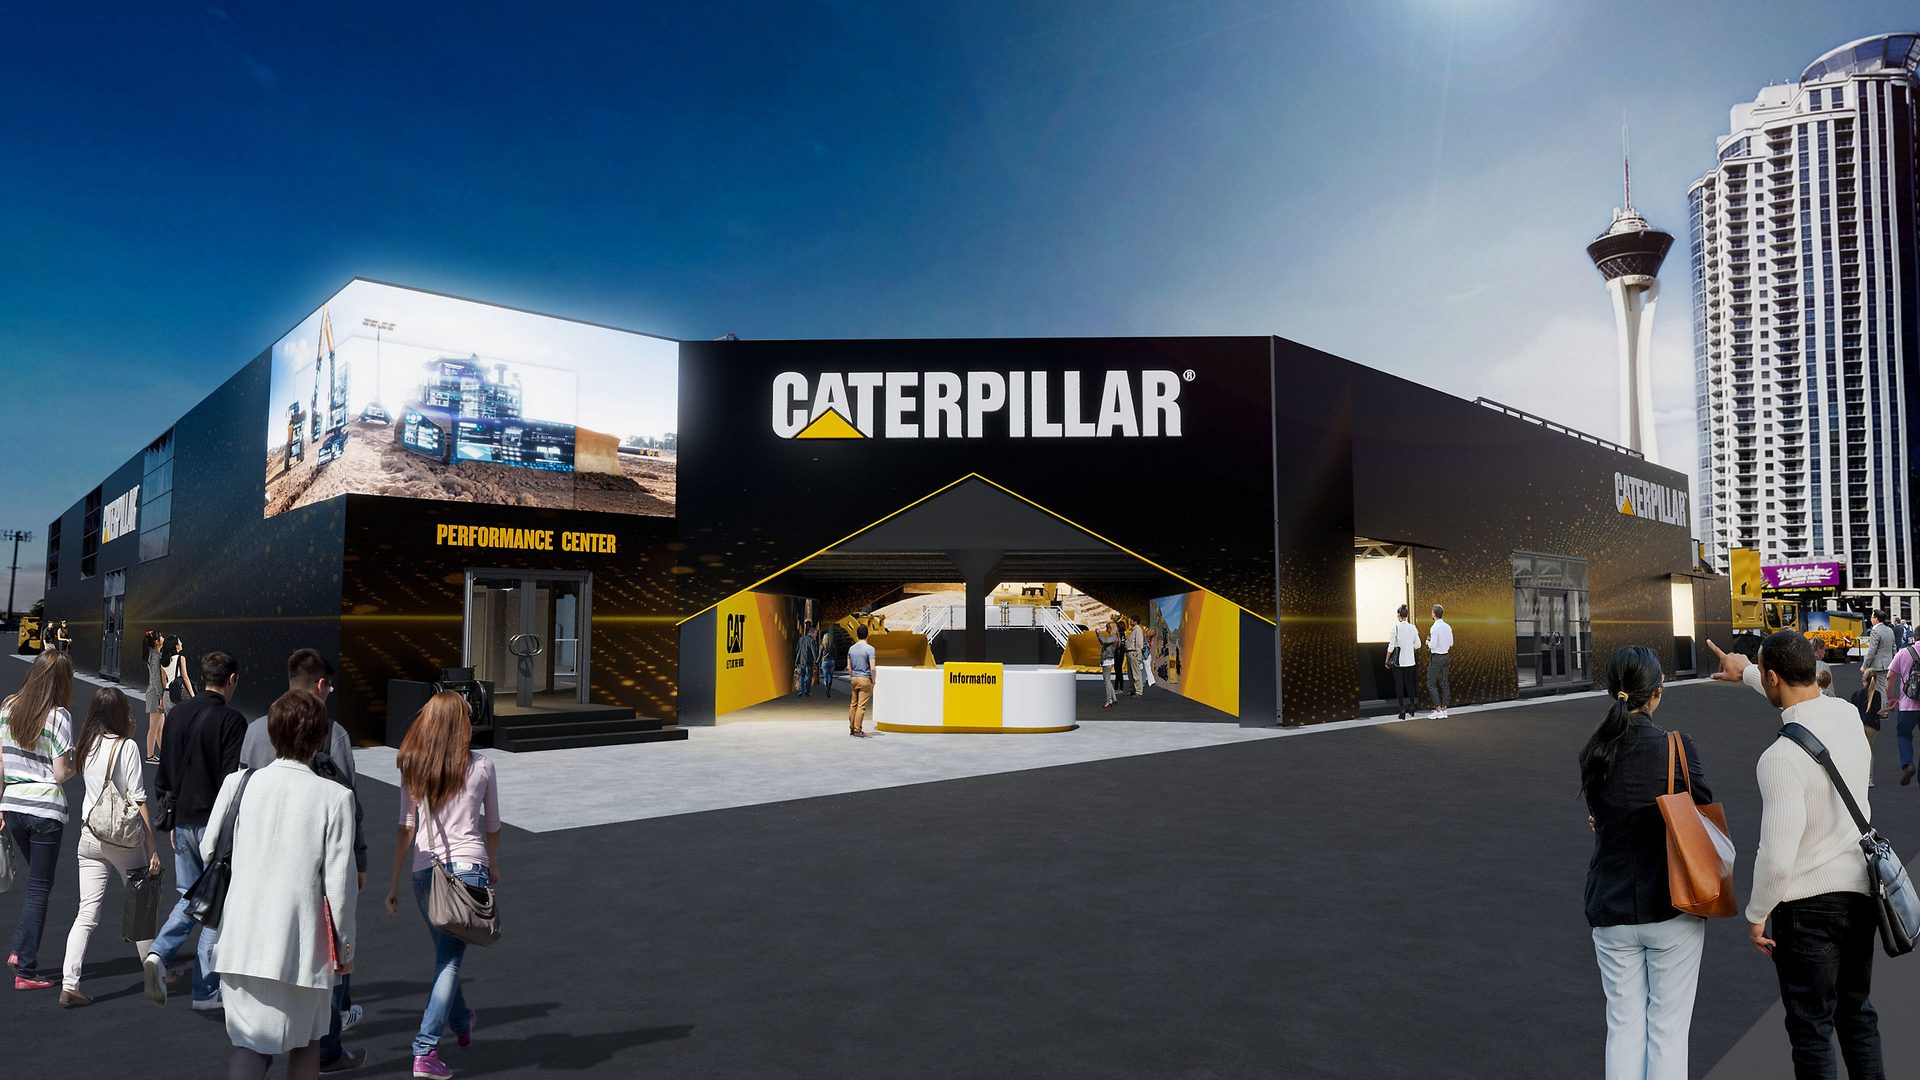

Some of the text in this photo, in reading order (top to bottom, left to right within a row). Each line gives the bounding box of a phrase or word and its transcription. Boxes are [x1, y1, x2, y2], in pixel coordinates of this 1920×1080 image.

[1614, 471, 1687, 527] CATERPILLAR
[436, 523, 617, 554] PERFORMANCE CENTER
[727, 613, 745, 653] CAT
[949, 671, 997, 685] Information
